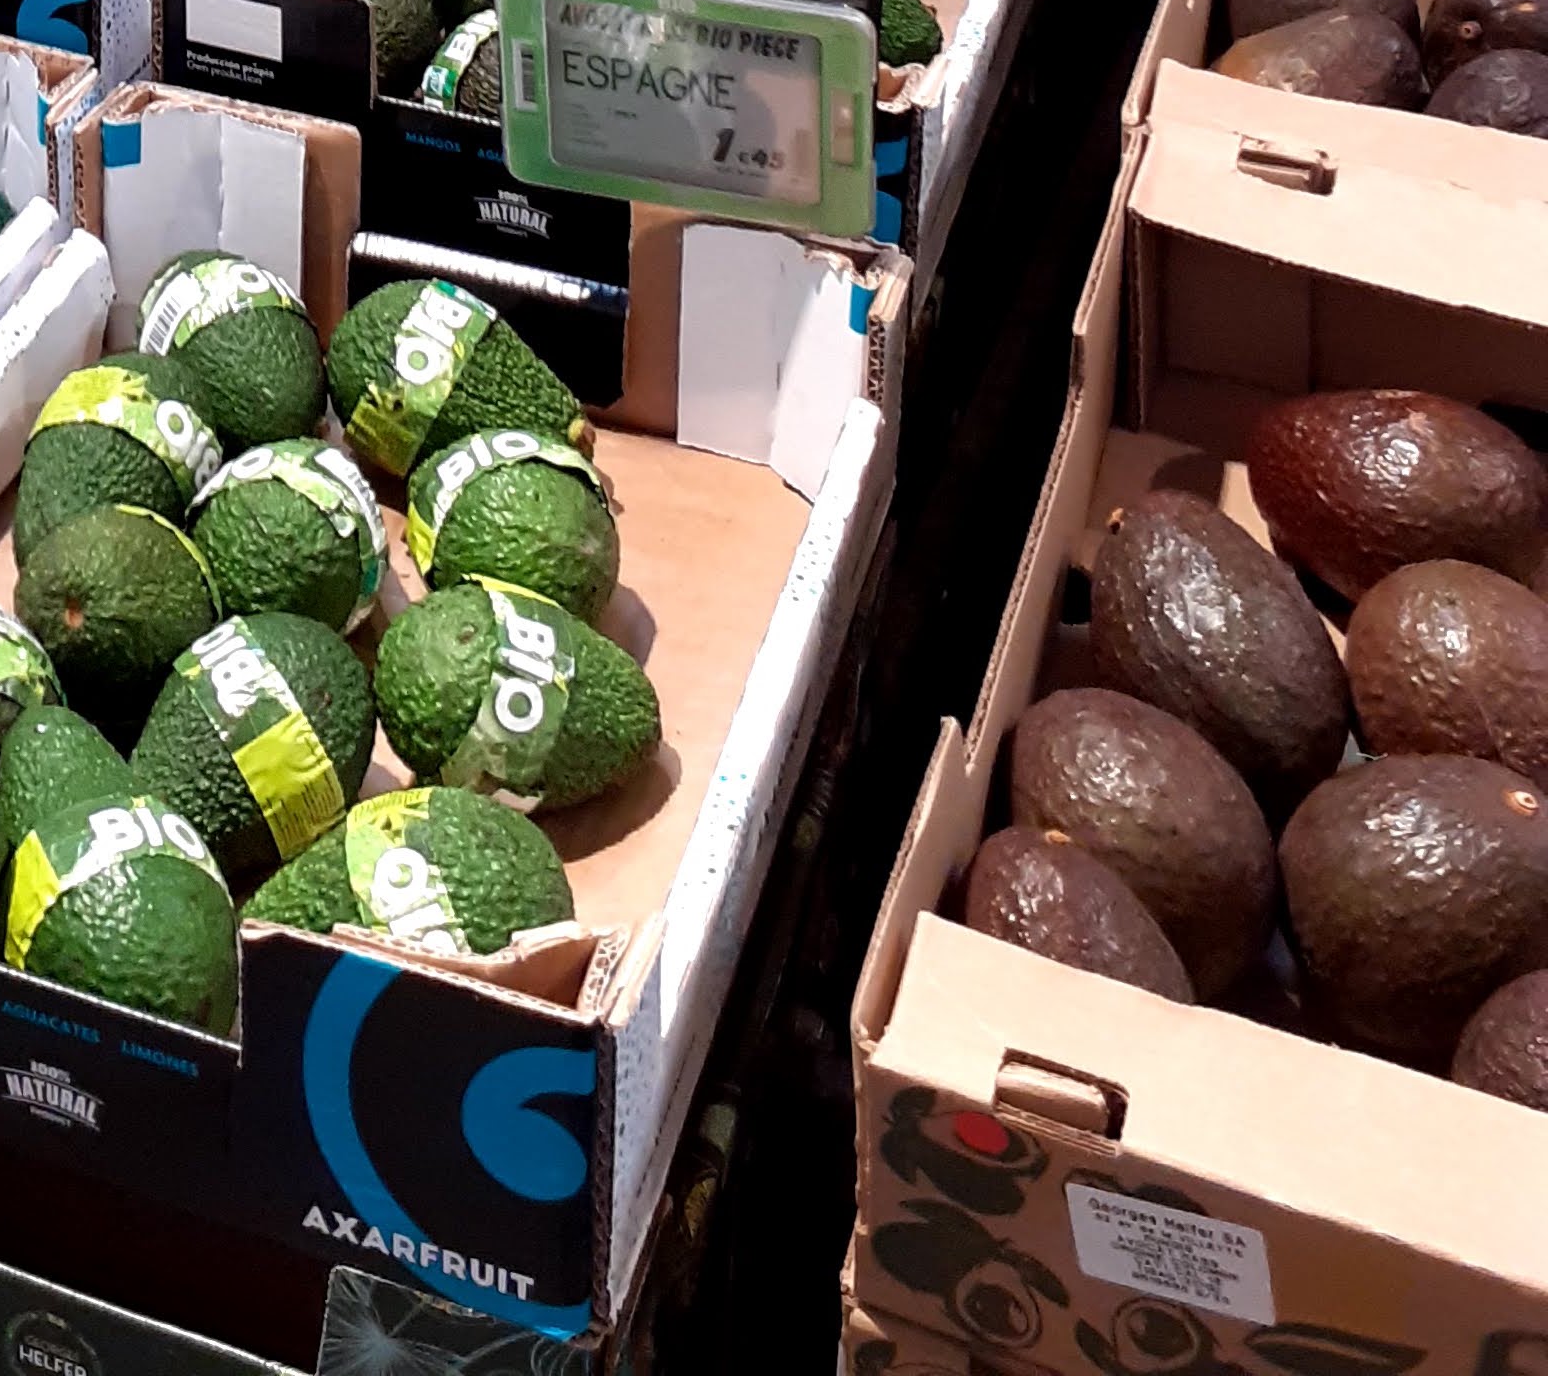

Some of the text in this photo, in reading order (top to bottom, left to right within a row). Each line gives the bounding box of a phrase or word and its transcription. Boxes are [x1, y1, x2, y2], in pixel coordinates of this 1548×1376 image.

[739, 30, 800, 62] PIECE
[562, 50, 737, 111] ESPAGNE
[478, 201, 548, 235] NATURAL
[396, 290, 473, 385] BIO
[438, 430, 541, 493] BIO
[495, 612, 556, 733] BIO
[88, 805, 205, 861] BIO
[5, 1072, 99, 1124] NATURAL
[302, 1204, 536, 1302] AXARFRUIT
